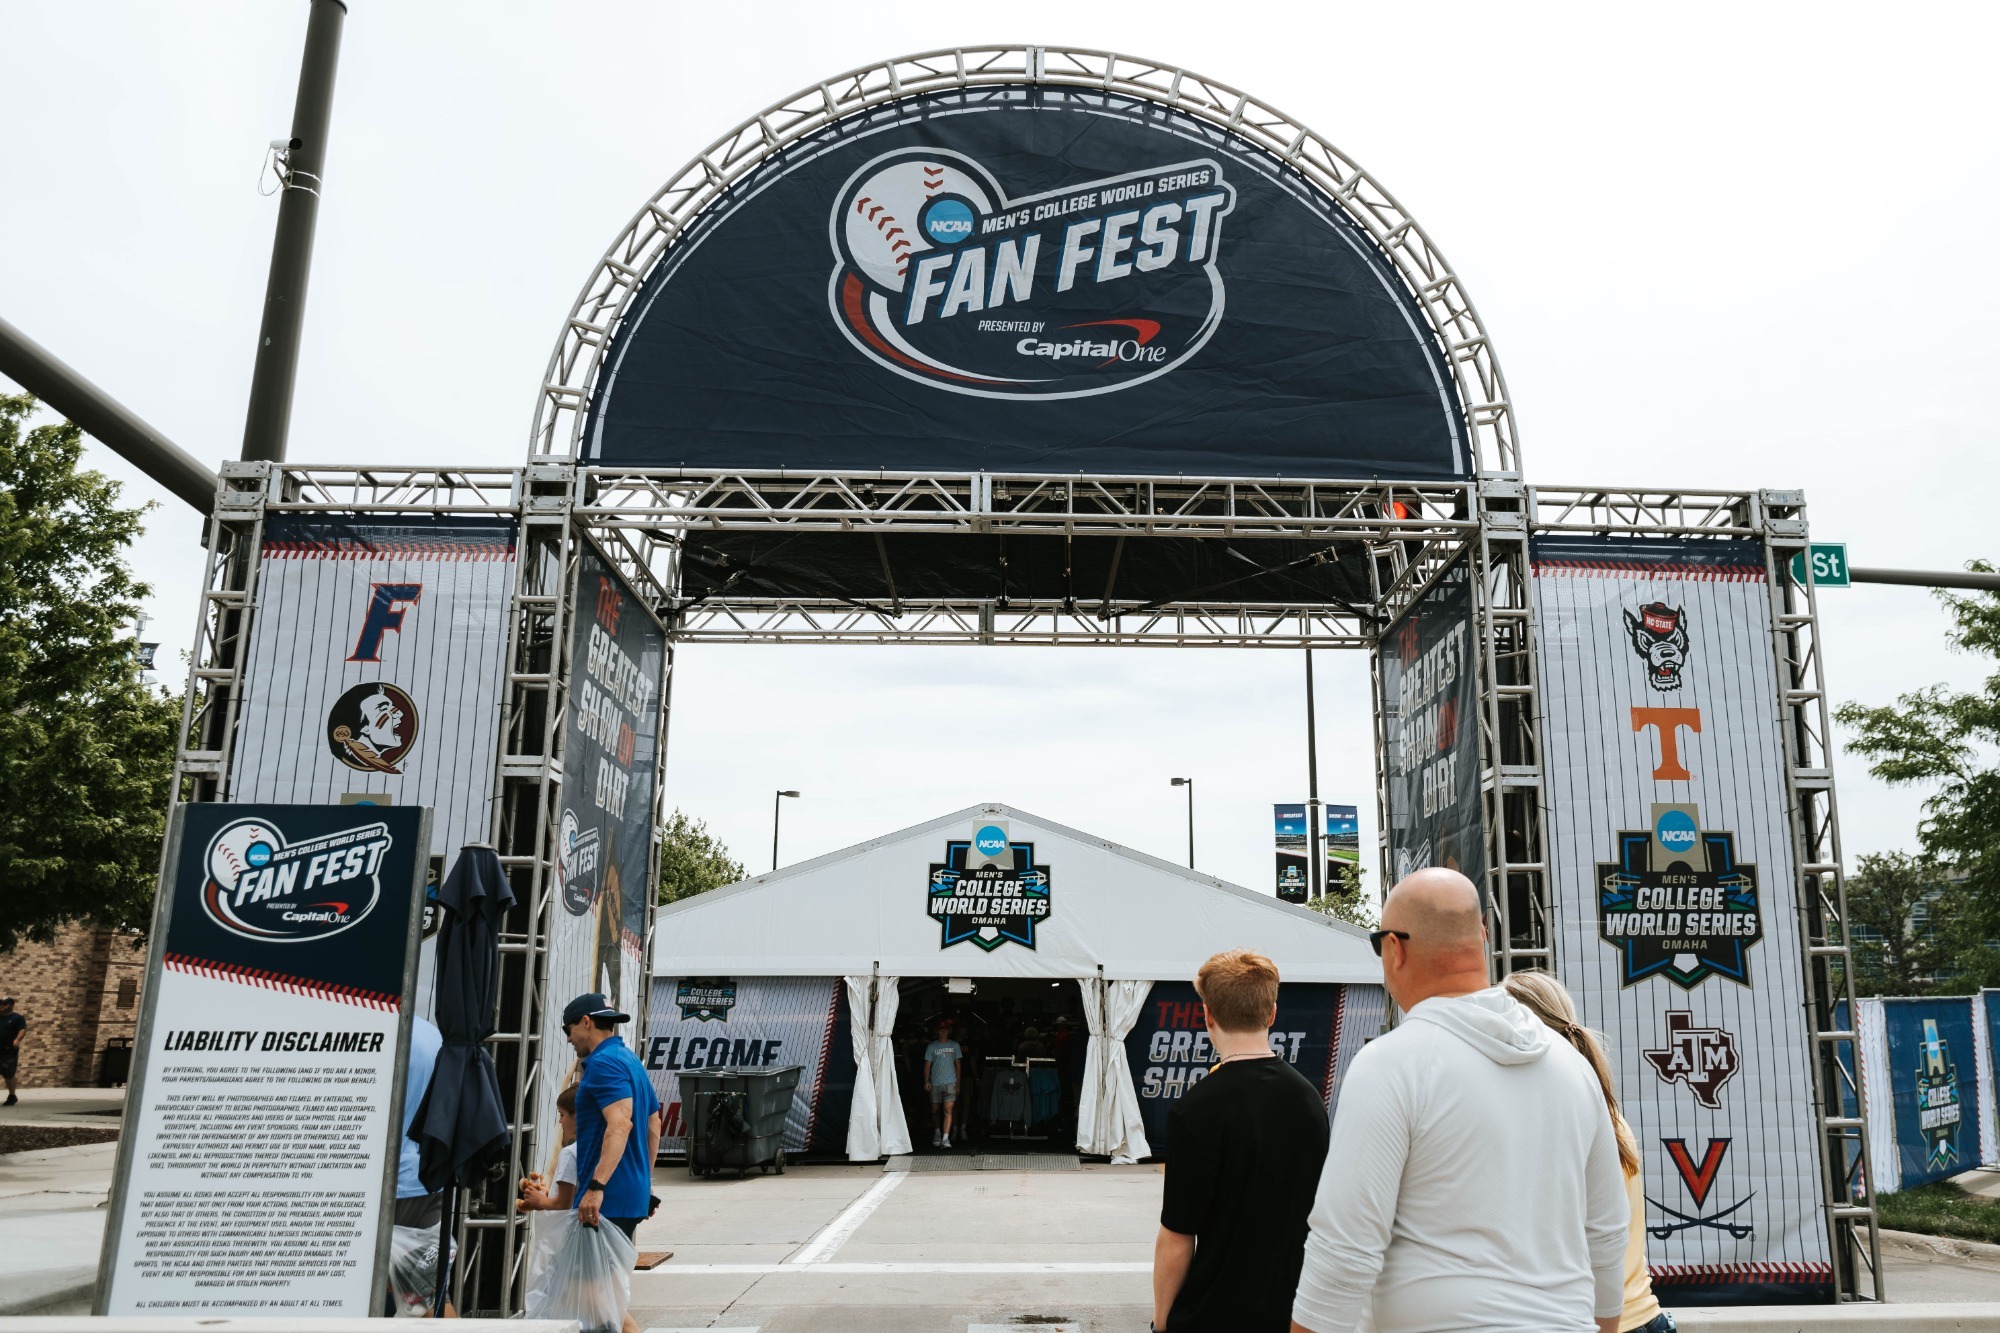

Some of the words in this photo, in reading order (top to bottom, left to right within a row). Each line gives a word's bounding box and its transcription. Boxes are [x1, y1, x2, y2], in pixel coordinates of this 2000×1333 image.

[982, 208, 1030, 234] MEN'S
[1034, 194, 1096, 221] COLLEGE
[1101, 182, 1154, 204] WORLD
[1158, 170, 1210, 194] SERIES
[930, 220, 973, 233] NCAA
[904, 233, 1041, 326] FAN
[1055, 192, 1224, 293] FEST
[978, 320, 1030, 333] PRESENTED
[1032, 321, 1045, 333] BY
[1812, 552, 1840, 578] St
[595, 575, 622, 637] THE
[345, 582, 423, 662] F
[1646, 616, 1655, 626] NC
[1655, 619, 1672, 630] STATE
[586, 622, 654, 724] GREATEST
[1399, 619, 1466, 724] GREATEST
[577, 679, 622, 758] SHOW
[618, 722, 636, 769] ON
[1400, 710, 1438, 777] SHOW
[1630, 706, 1702, 780] T
[595, 760, 630, 822] DIRT
[1422, 750, 1457, 819] DIRT
[273, 848, 297, 862] MEN'S
[298, 842, 328, 856] COLLEGE
[329, 834, 354, 849] WORLD
[356, 828, 382, 842] SERIES
[978, 840, 1006, 848] NCAA
[1661, 830, 1696, 842] NCAA
[578, 842, 598, 876] FEST
[234, 860, 300, 907] FAN
[303, 840, 386, 890] FEST
[1661, 874, 1698, 884] MEN'S
[955, 880, 1024, 896] COLLEGE
[1636, 887, 1725, 910] COLLEGE
[932, 897, 988, 914] WORLD
[990, 898, 1047, 915] SERIES
[1606, 912, 1682, 936] WORLD
[1686, 912, 1756, 936] SERIES
[1662, 940, 1708, 950] OMAHA
[678, 996, 706, 1004] WORLD
[706, 997, 734, 1006] SERIES
[690, 988, 724, 997] COLLEGE
[1157, 1002, 1204, 1028] THE
[164, 1030, 258, 1052] LIABILITY
[262, 1032, 384, 1053] DISCLAIMER
[647, 1037, 782, 1070] ELCOME
[288, 1076, 322, 1084] FOLLOWING
[323, 1076, 333, 1084] ON
[335, 1067, 348, 1075] ARE
[349, 1067, 353, 1075] A
[314, 1095, 322, 1103] BY
[338, 1114, 353, 1122] FILM
[197, 1142, 230, 1150] AUTHORIZE
[136, 1300, 146, 1308] ALL
[301, 1299, 308, 1307] AT
[310, 1299, 320, 1307] ALL
